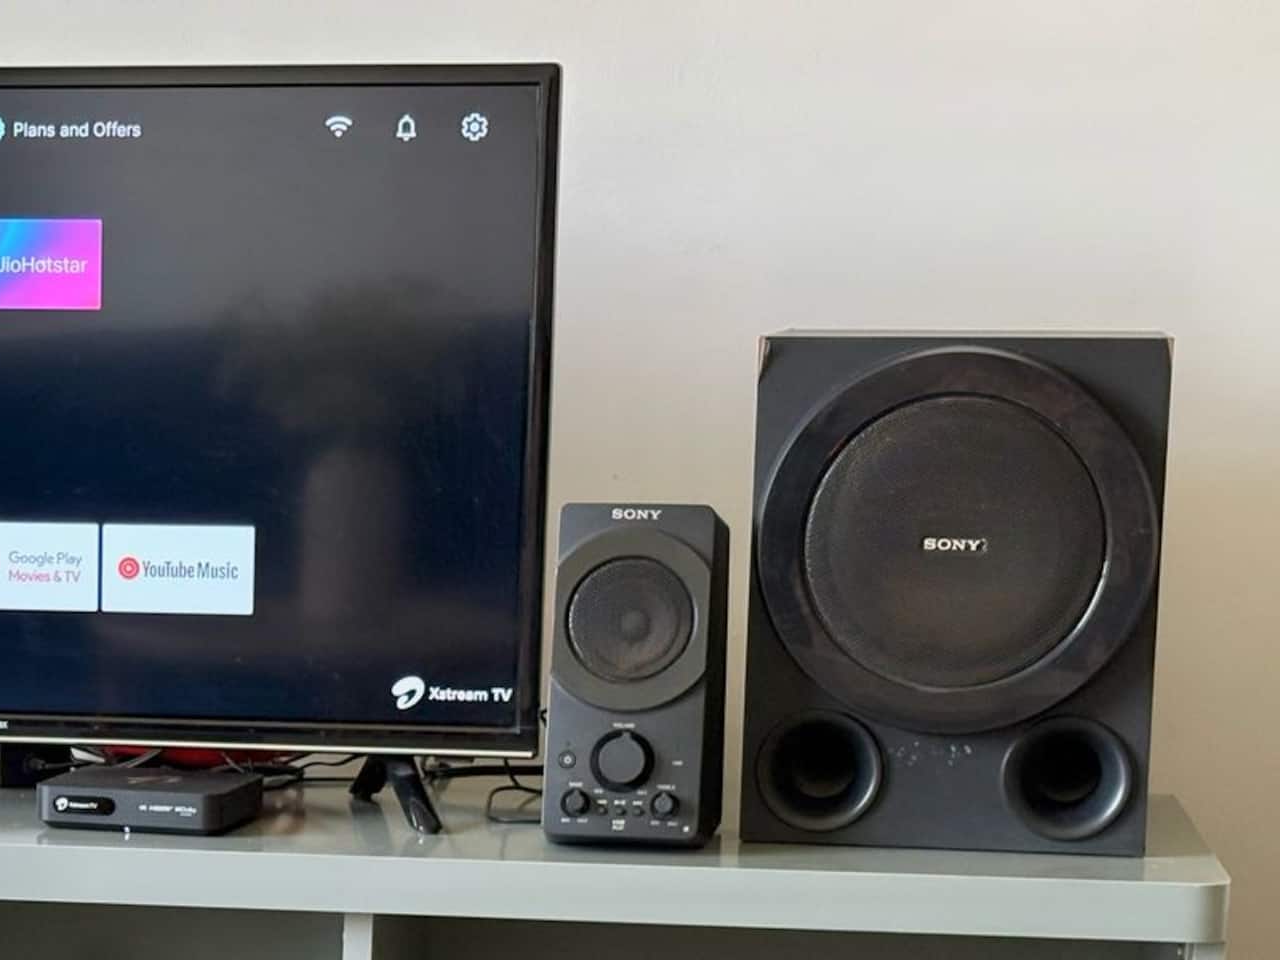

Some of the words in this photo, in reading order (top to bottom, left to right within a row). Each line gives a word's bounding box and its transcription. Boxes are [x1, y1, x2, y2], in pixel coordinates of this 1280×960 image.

[13, 121, 55, 138] Plans
[59, 121, 89, 138] and
[93, 121, 142, 138] Offers
[611, 507, 662, 521] SONY
[923, 537, 981, 552] SONY
[8, 551, 53, 568] Google
[55, 552, 83, 569] Play
[8, 569, 50, 583] Movies
[52, 570, 63, 583] &
[65, 570, 81, 583] TV
[142, 560, 195, 579] YouTube
[196, 561, 239, 580] Music
[428, 686, 489, 702] Xstream
[491, 687, 513, 702] TV
